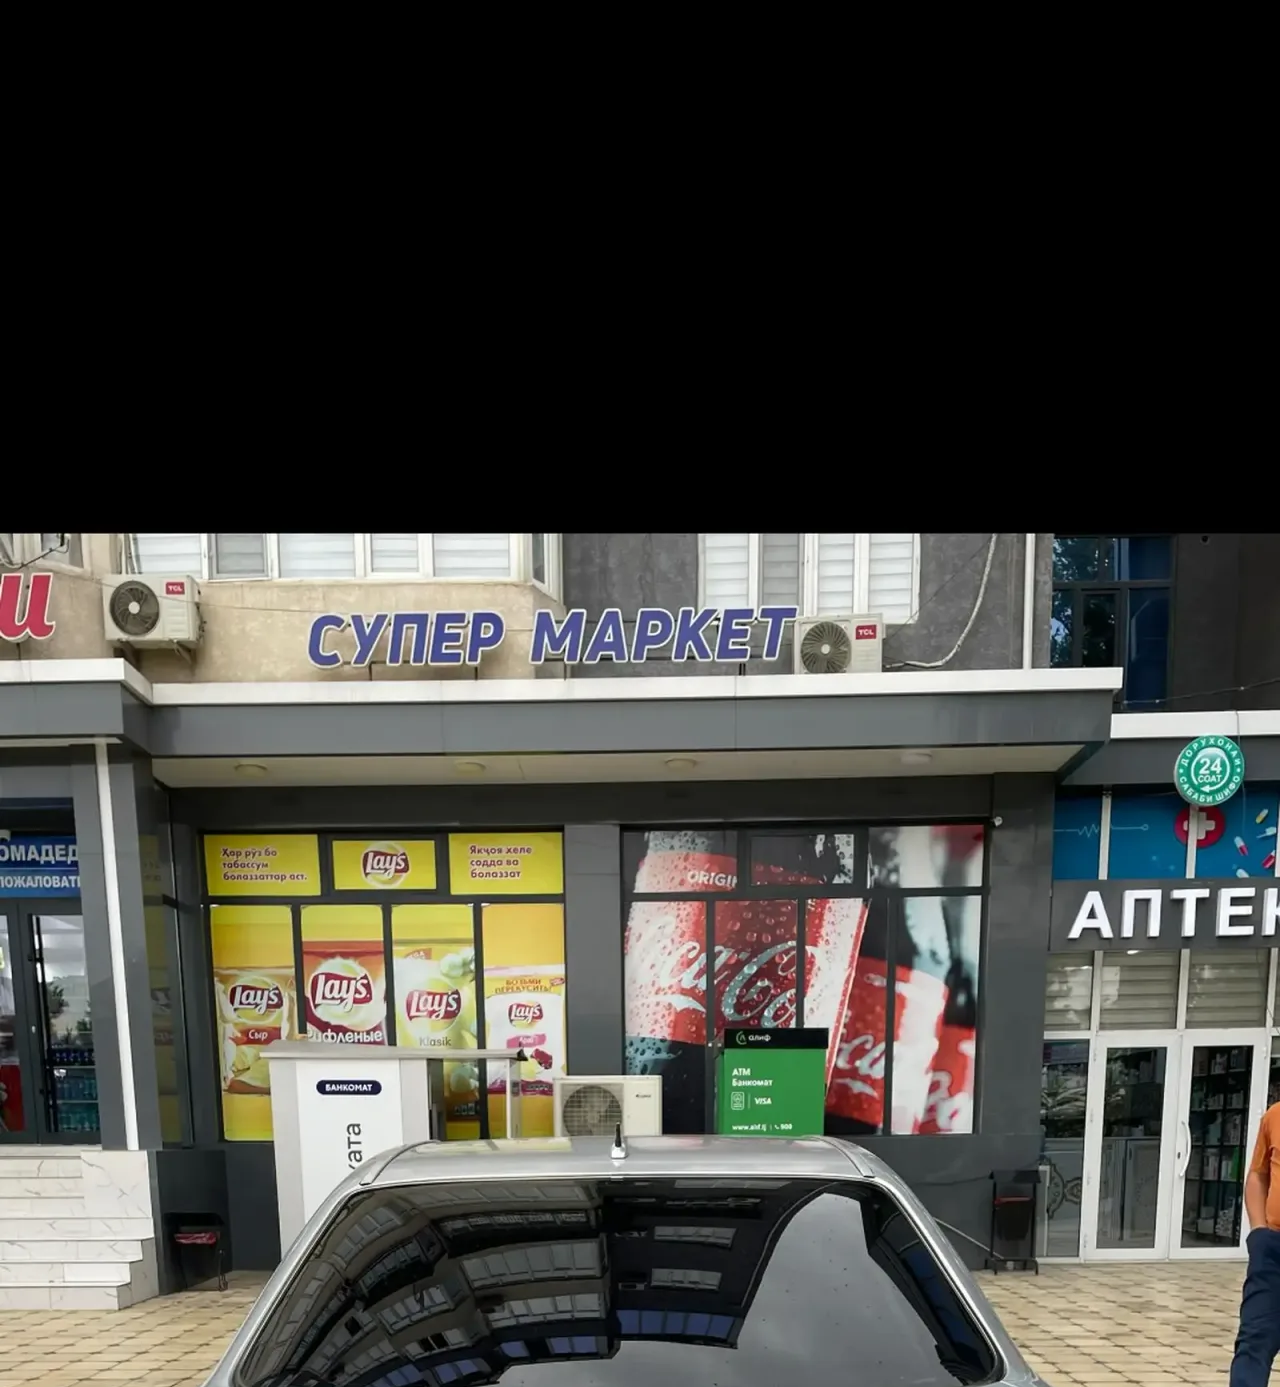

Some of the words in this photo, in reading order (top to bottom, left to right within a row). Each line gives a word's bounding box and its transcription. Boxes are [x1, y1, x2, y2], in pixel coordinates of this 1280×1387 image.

[308, 611, 506, 669] СУПЕР
[531, 606, 799, 664] МАРКЕТ
[1199, 758, 1222, 775] 24
[1198, 775, 1222, 784] СОАТ
[1180, 776, 1213, 803] САБАБИ
[1215, 775, 1240, 801] ШИФО
[264, 847, 278, 857] бо
[505, 846, 533, 855] хеле
[223, 860, 269, 870] табассум
[365, 851, 407, 880] Lay's
[470, 859, 504, 868] содда
[223, 872, 287, 884] болаззаттар
[470, 868, 522, 879] болаззат
[315, 974, 370, 1013] Lay's
[231, 984, 279, 1015] Lay's
[409, 990, 459, 1020] Lay's
[510, 1003, 541, 1024] Lay's
[248, 1029, 268, 1041] Сыр
[420, 1037, 452, 1046] Klasik
[325, 1083, 373, 1092] БАНКОМАТ
[732, 1078, 773, 1087] Банкомат
[754, 1097, 772, 1105] VISA
